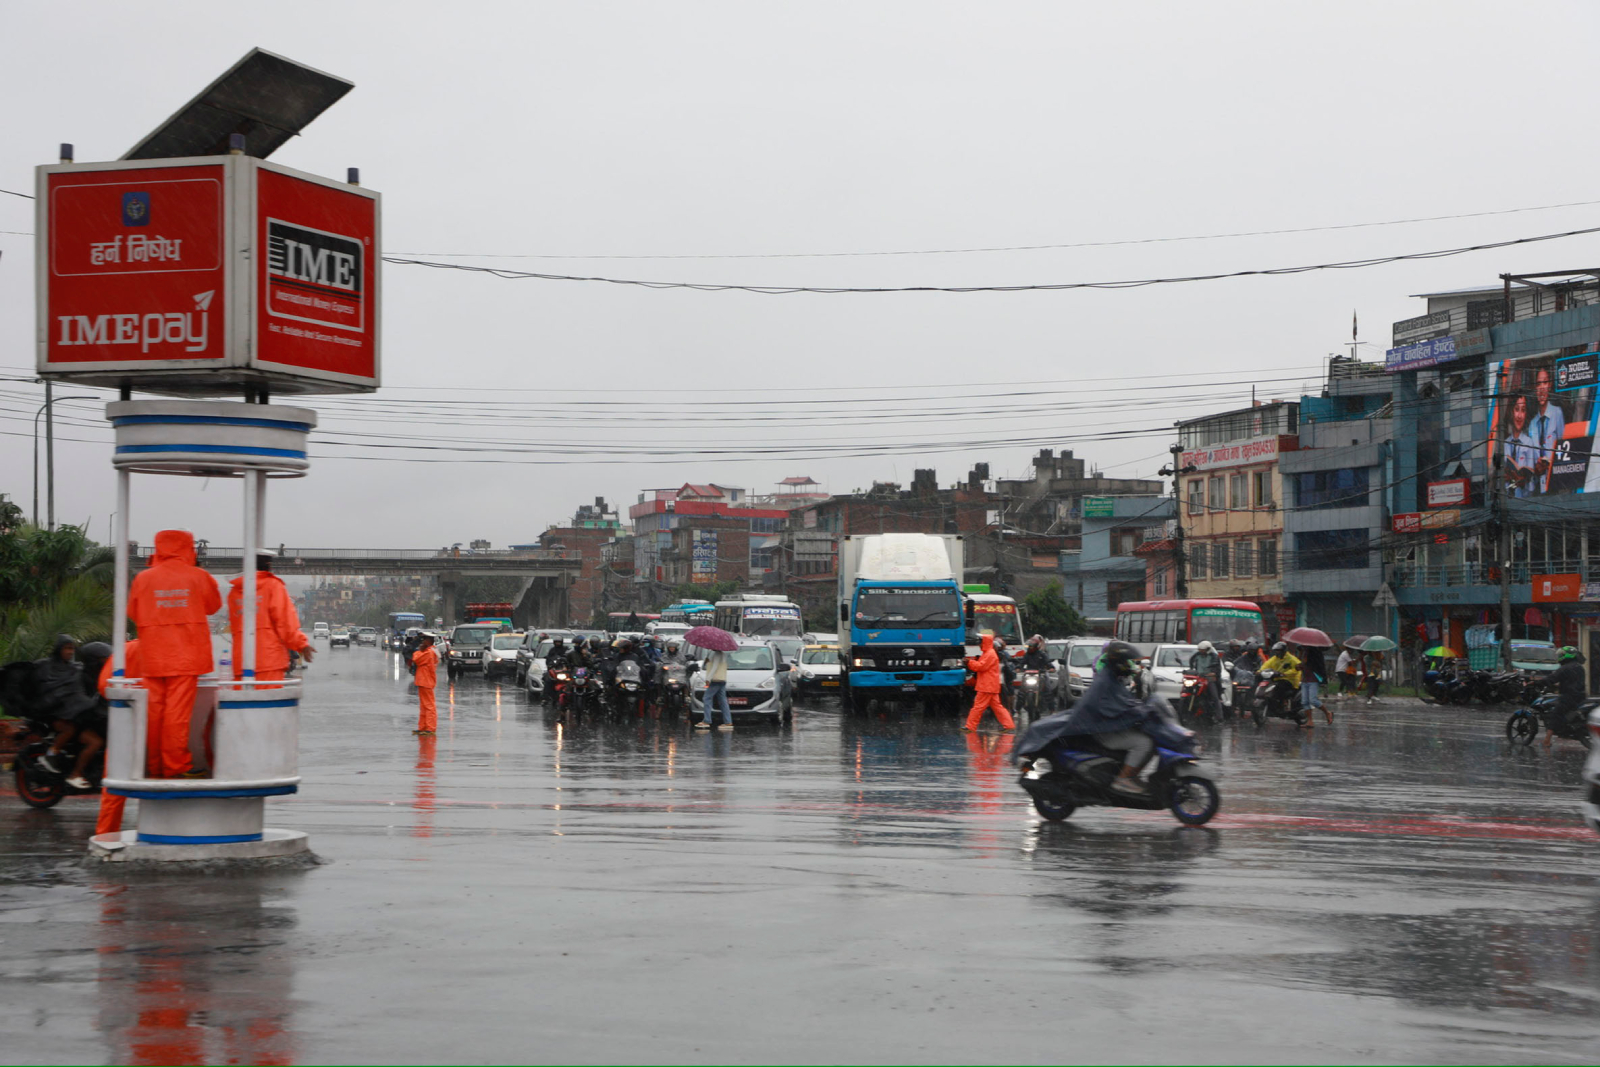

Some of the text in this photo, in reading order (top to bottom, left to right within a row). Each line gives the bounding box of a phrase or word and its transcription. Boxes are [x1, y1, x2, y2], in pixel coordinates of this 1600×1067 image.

[91, 234, 182, 265] हर्न निषेध
[283, 239, 355, 291] IME
[57, 311, 209, 353] IMEpay
[1568, 361, 1590, 372] NOBEL
[1556, 440, 1571, 462] +2
[1552, 462, 1586, 475] MANAGEMENT
[154, 589, 189, 597] TRAFFIC
[156, 600, 188, 608] POLICE
